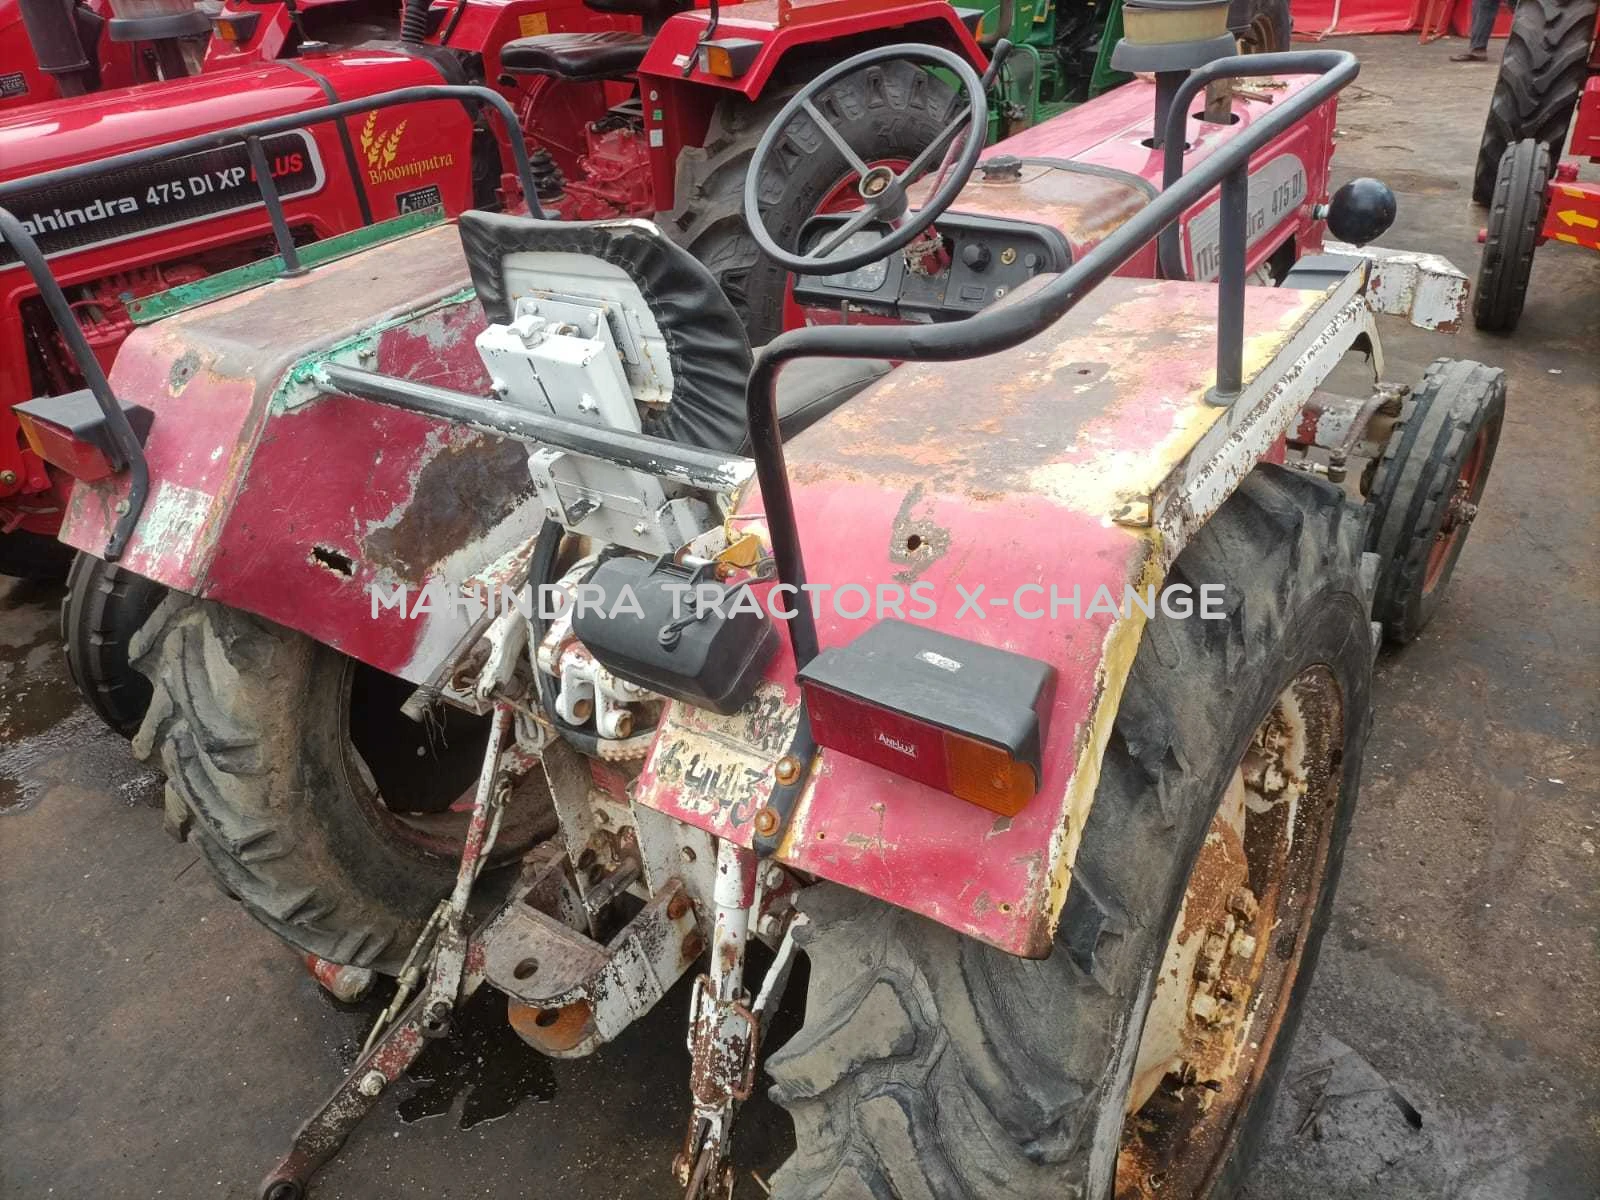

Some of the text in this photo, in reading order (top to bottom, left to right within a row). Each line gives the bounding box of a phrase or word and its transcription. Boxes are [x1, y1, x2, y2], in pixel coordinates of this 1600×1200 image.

[145, 180, 186, 206] 475
[190, 173, 214, 197] DI
[217, 166, 246, 190] XP
[1271, 181, 1290, 216] 475
[1292, 169, 1303, 200] DI
